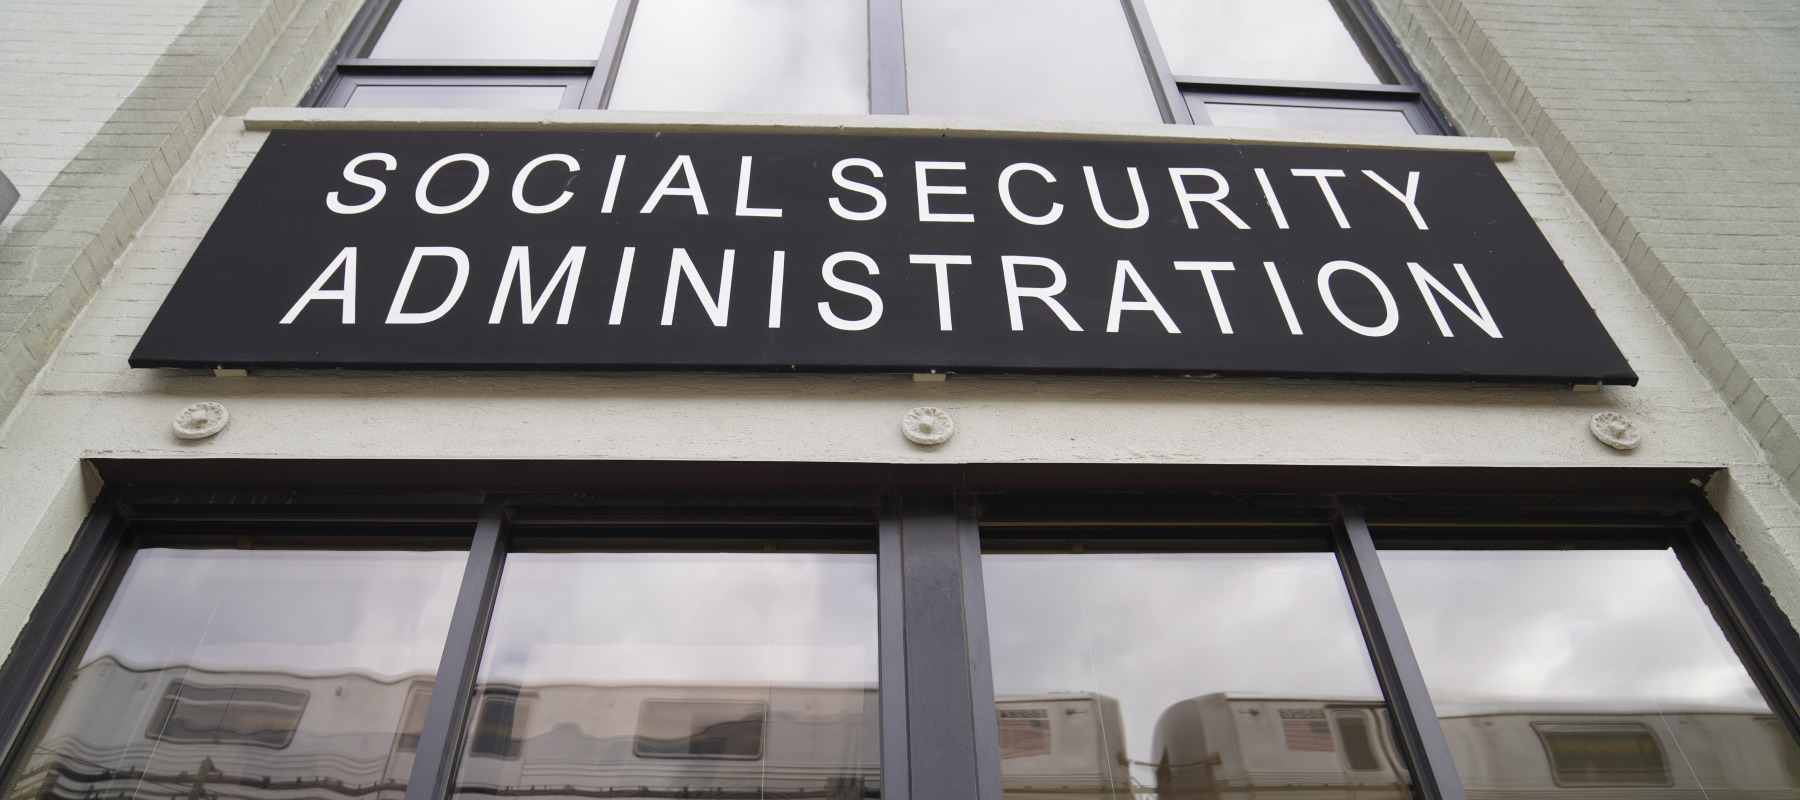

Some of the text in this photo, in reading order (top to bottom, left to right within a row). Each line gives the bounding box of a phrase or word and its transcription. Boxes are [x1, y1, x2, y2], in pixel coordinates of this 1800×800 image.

[326, 153, 1429, 230] SOCIAL SECURITY
[279, 246, 1504, 338] ADMINISTRATION
